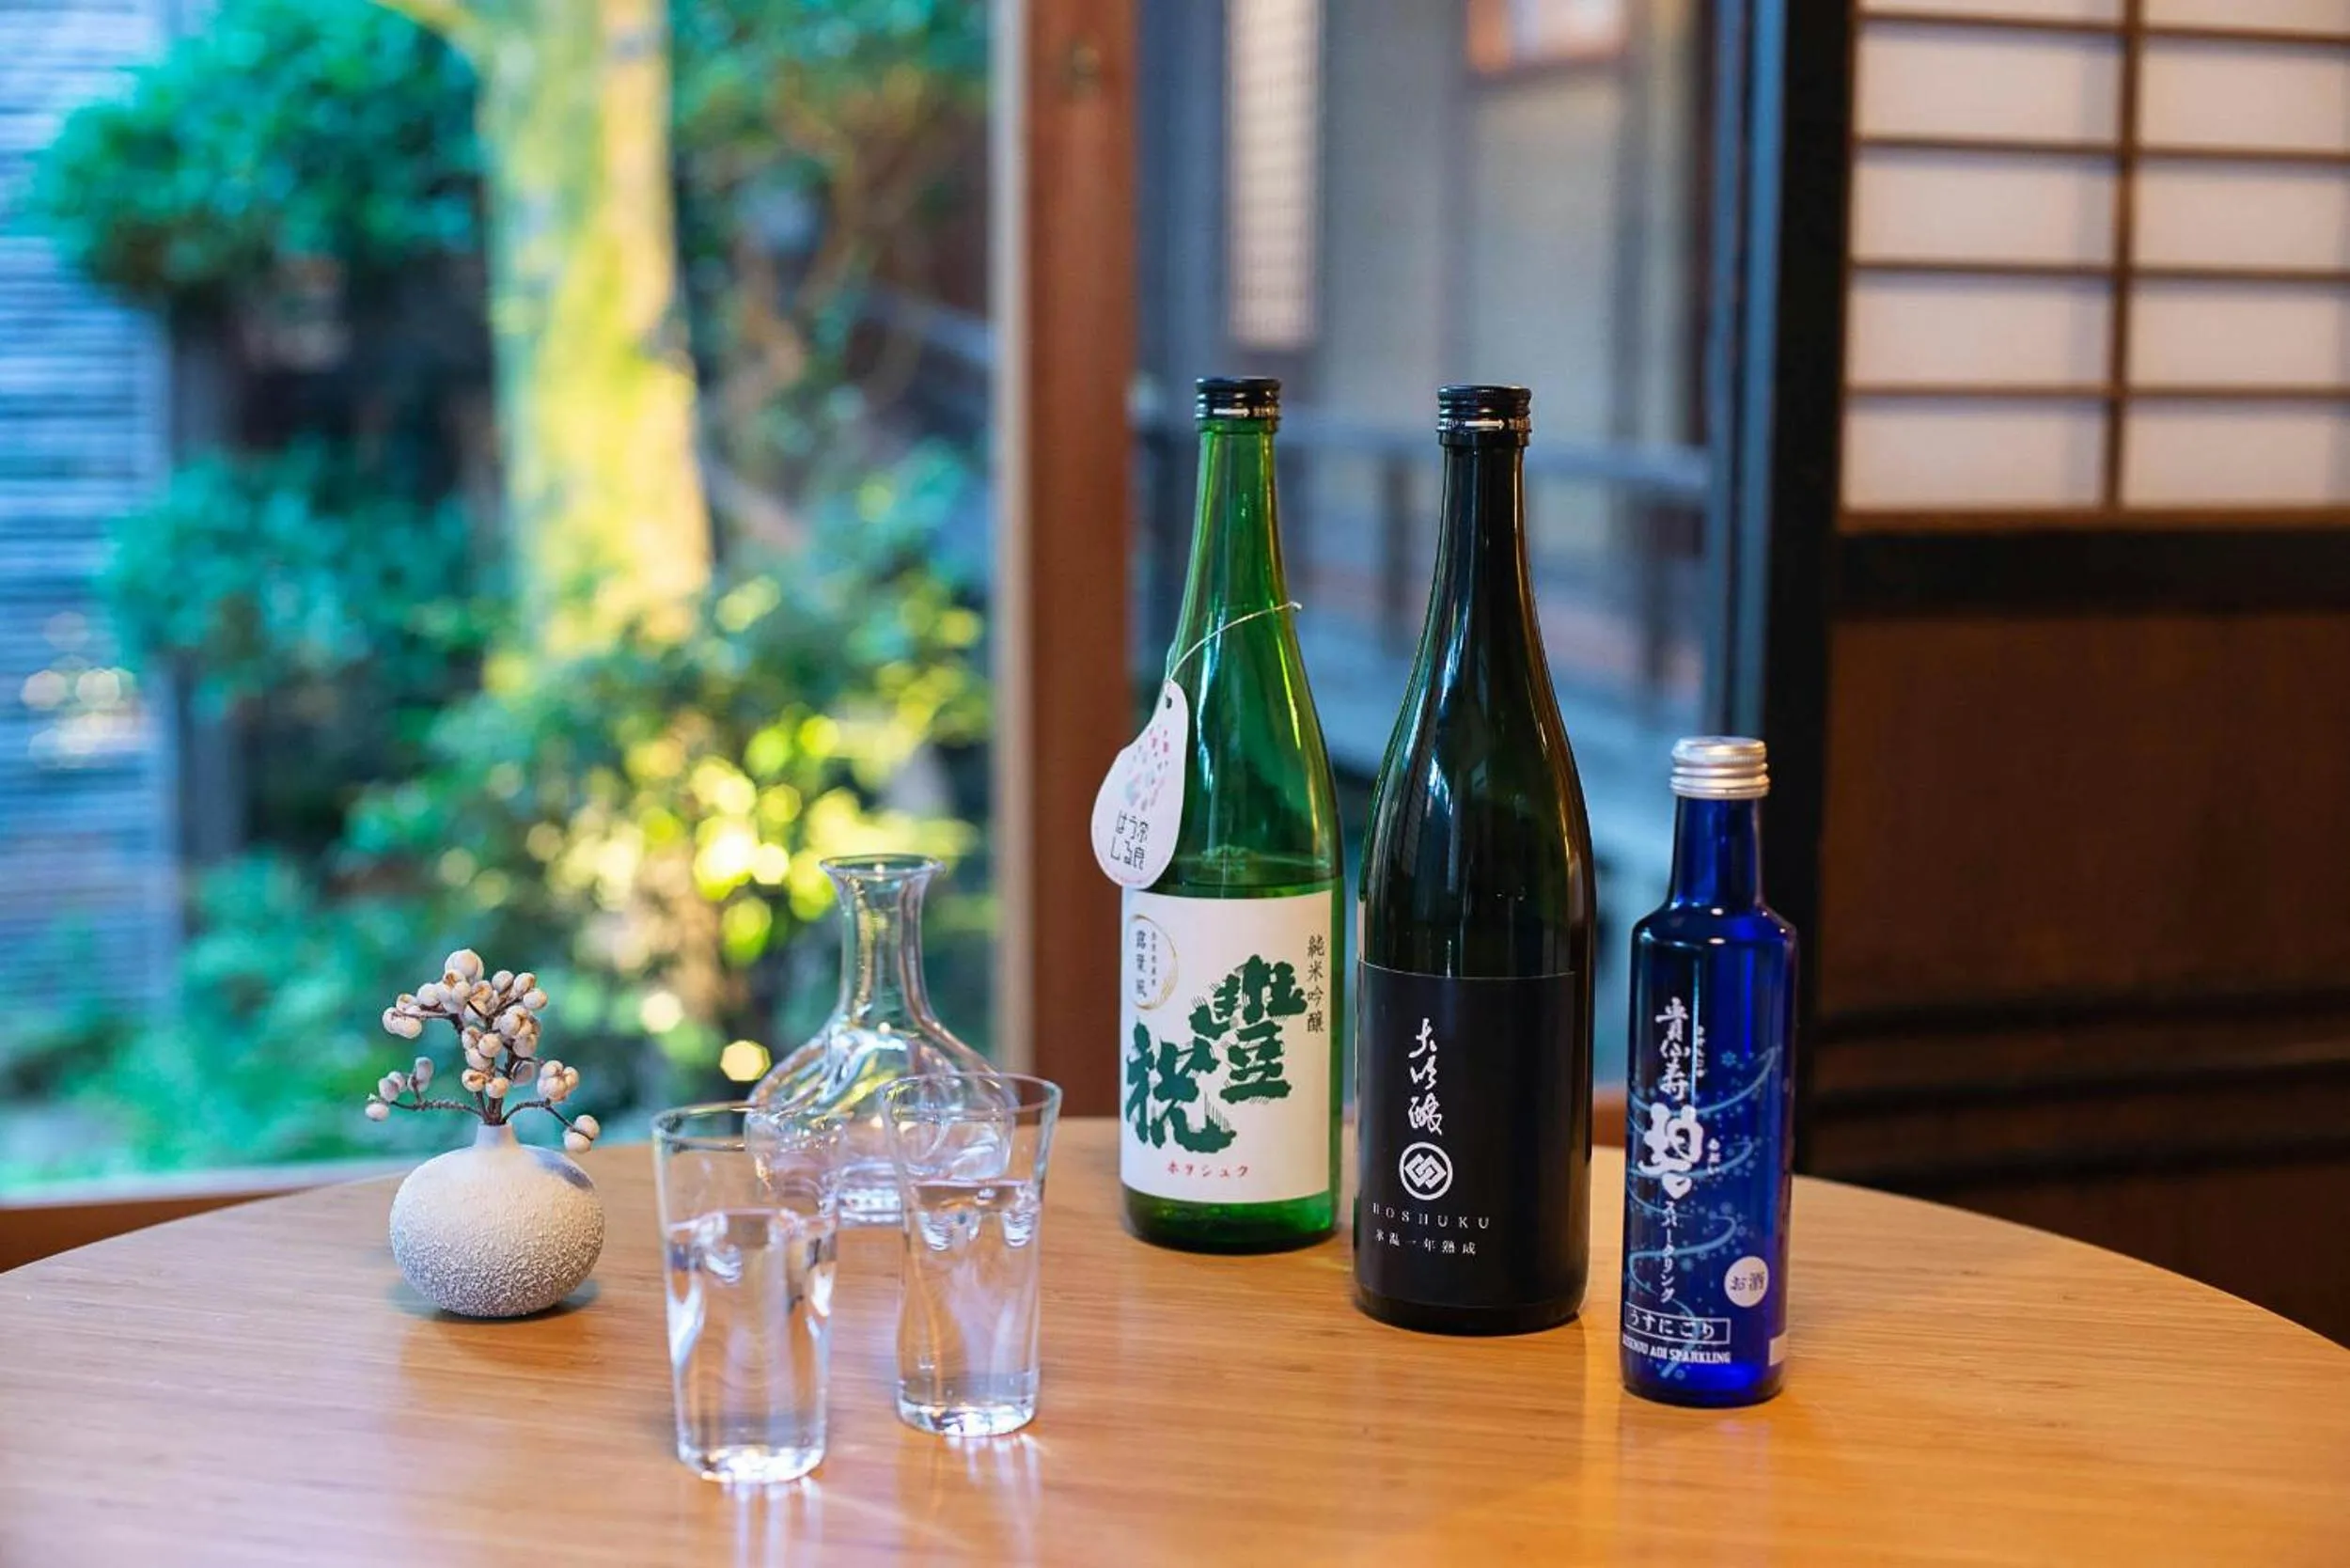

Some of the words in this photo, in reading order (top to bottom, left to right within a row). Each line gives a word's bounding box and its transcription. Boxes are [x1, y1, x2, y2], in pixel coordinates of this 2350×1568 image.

[1307, 933, 1325, 1034] 純米吟醸
[1372, 1202, 1490, 1230] HOSHUKU
[1731, 1271, 1765, 1292] お酒
[1668, 1347, 1731, 1364] SPARKLING
